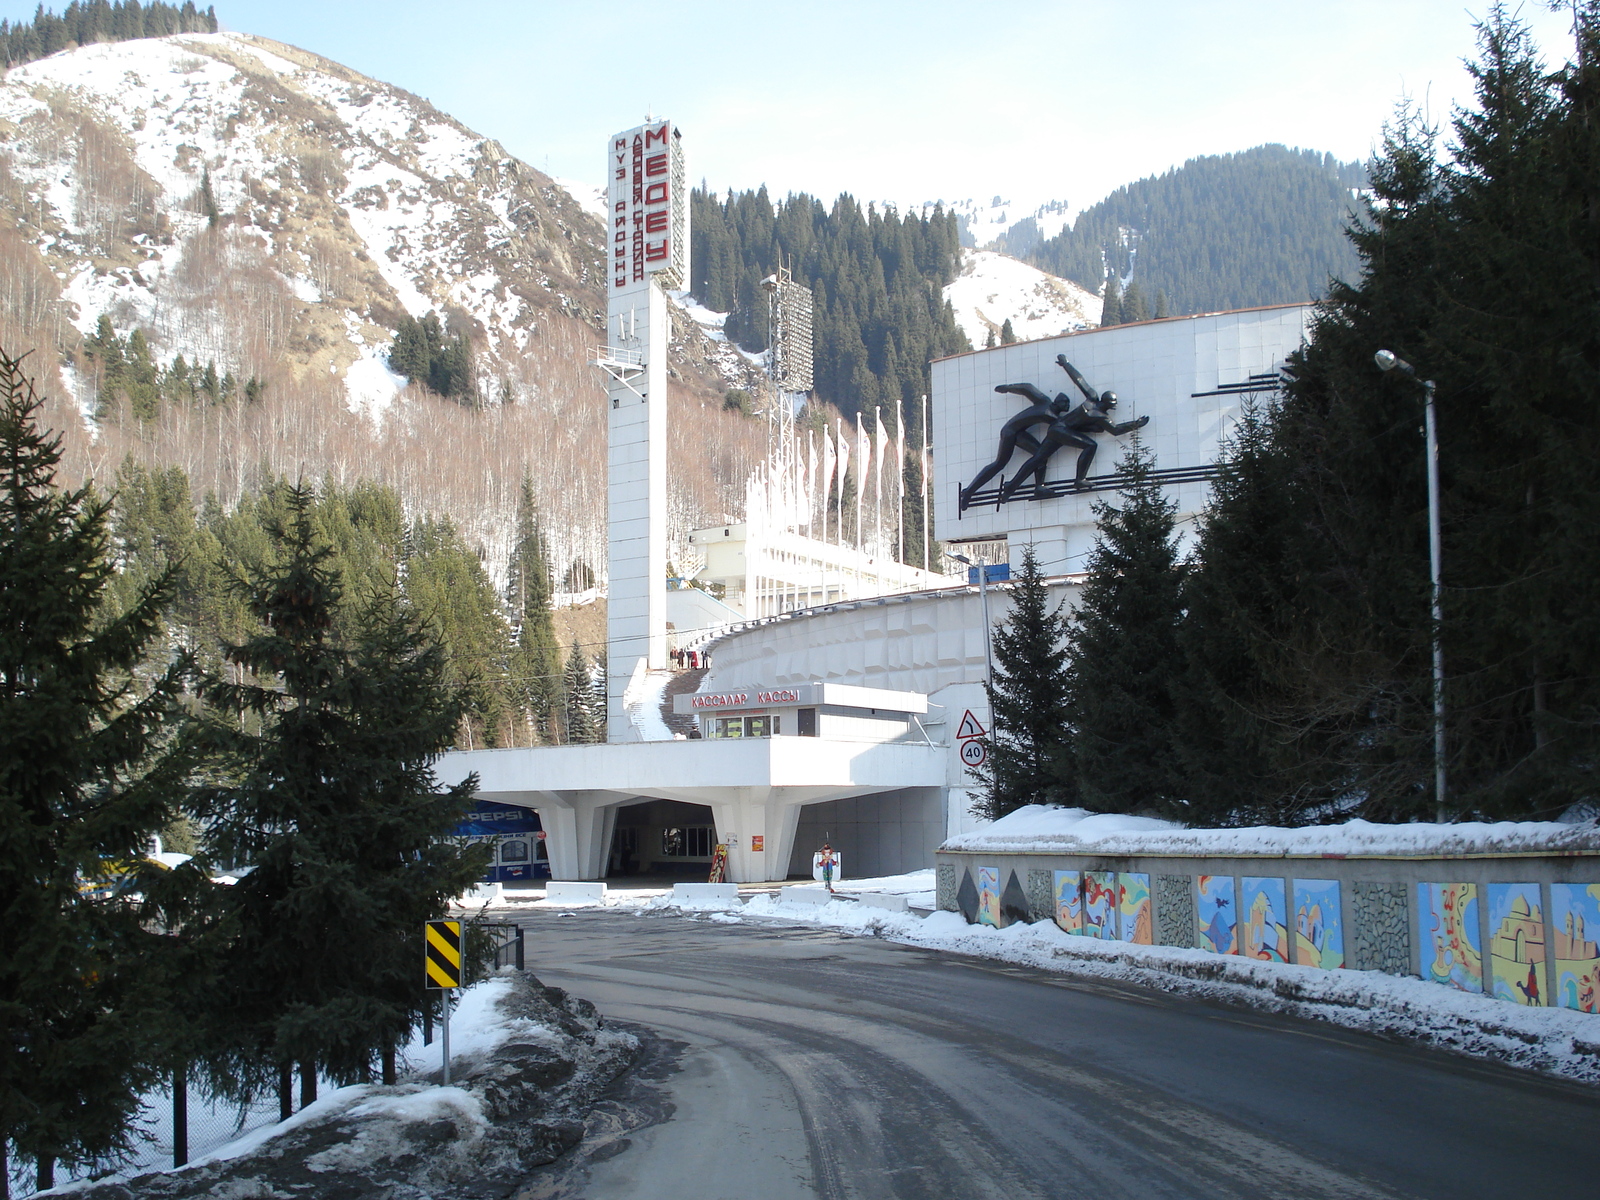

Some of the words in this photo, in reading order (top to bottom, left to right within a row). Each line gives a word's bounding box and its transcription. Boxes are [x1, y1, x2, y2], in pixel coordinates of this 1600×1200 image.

[645, 125, 668, 262] МЕДЕУ
[632, 210, 643, 283] СТАДИОН
[692, 693, 748, 708] КАССАЛАР
[758, 689, 800, 704] КАССЫ
[965, 746, 981, 758] 40
[468, 811, 523, 822] PEPSI
